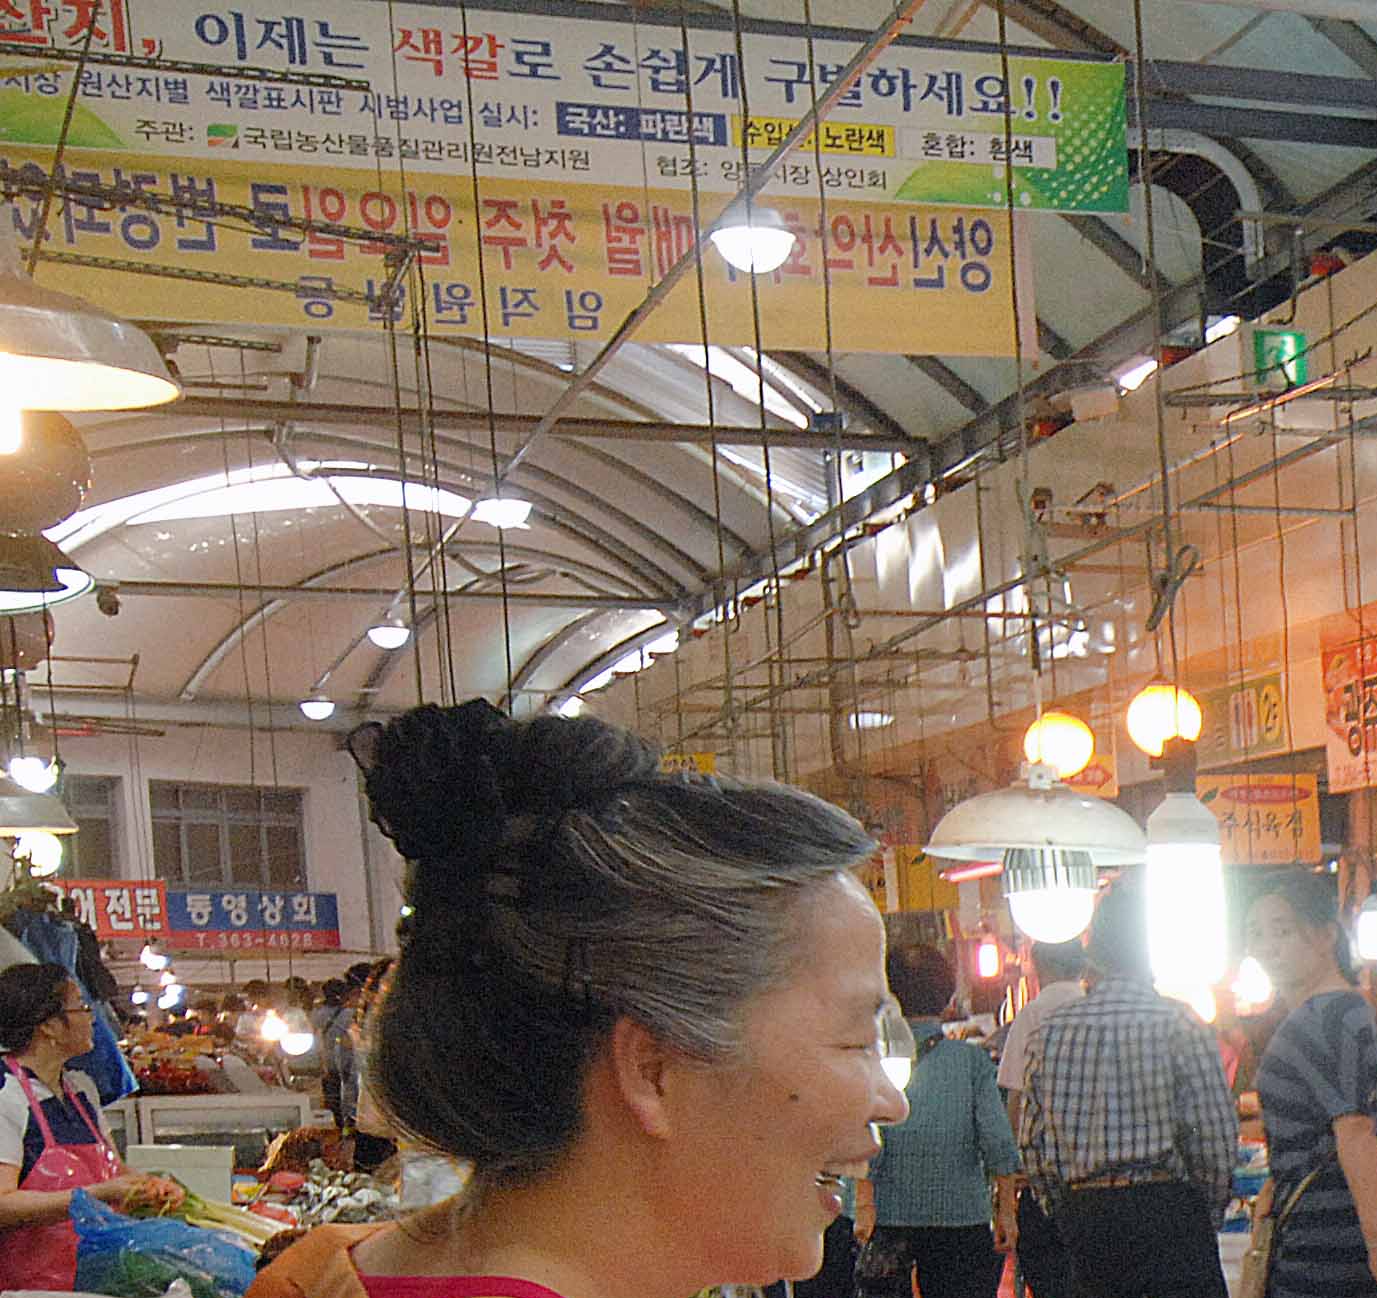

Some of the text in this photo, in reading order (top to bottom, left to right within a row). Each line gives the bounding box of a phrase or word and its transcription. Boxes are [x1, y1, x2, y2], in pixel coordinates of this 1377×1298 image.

[195, 11, 370, 69] 이제는
[394, 27, 561, 80] 색깔로
[584, 43, 739, 98] 손쉽게
[80, 70, 190, 104] 원산지별
[205, 81, 342, 116] 색깔표시판
[360, 94, 464, 125] 시범사업
[479, 102, 539, 130] 실시:
[565, 108, 626, 134] 국산:
[640, 113, 714, 143] 파란색
[745, 121, 812, 148] 수입:
[825, 126, 885, 153] 노란색
[922, 132, 975, 159] 혼합:
[134, 119, 194, 144] 주관:
[656, 155, 708, 177] 협조:
[720, 160, 810, 186] 양시장
[822, 165, 887, 190] 상인회
[105, 888, 161, 931] 전문
